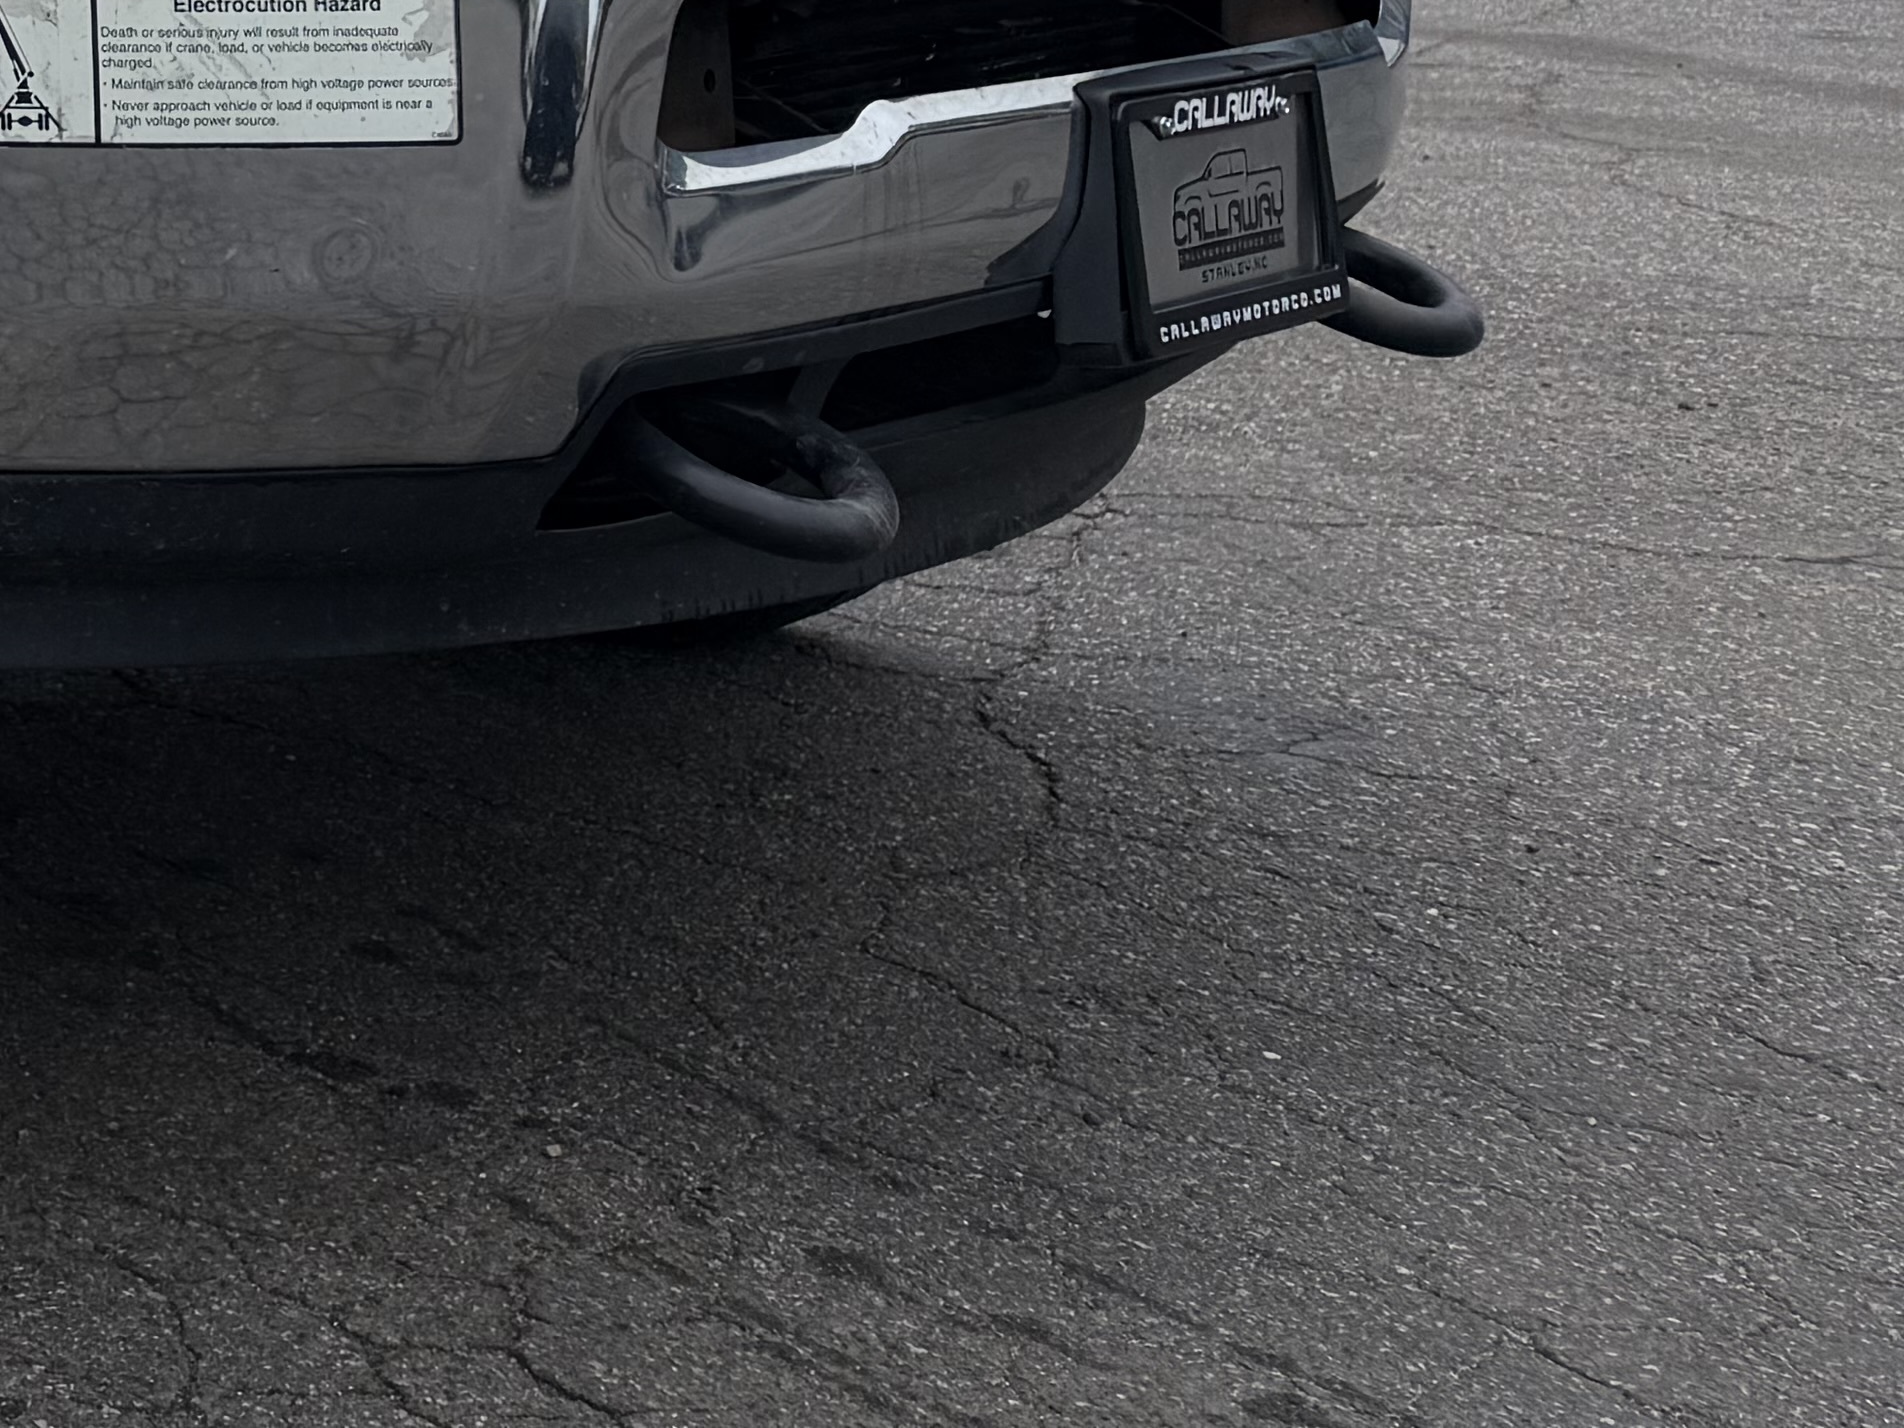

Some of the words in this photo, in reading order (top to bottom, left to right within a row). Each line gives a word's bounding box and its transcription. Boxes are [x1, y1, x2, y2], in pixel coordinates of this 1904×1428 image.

[100, 26, 138, 39] Death
[141, 28, 155, 39] or
[157, 26, 204, 39] serious
[206, 26, 240, 42] injury
[243, 26, 263, 38] will
[265, 26, 299, 37] result
[302, 26, 330, 38] from
[333, 26, 399, 41] inadequate
[100, 42, 162, 54] clearance
[251, 43, 265, 54] or
[268, 41, 310, 53] vehicle
[313, 40, 368, 53] becomes
[371, 40, 433, 54] electrically
[111, 77, 164, 92] Maintain
[167, 78, 194, 90] safe
[197, 78, 258, 90] clearance
[260, 78, 288, 90] from
[291, 77, 317, 92] high
[320, 77, 365, 92] voltage
[367, 79, 404, 91] power
[111, 99, 149, 112] Never
[152, 99, 211, 114] approach
[213, 99, 257, 112] vehicle
[260, 101, 273, 111] or
[276, 99, 303, 111] load
[305, 99, 313, 111] if
[316, 99, 380, 113] equipment
[382, 98, 393, 110] is
[395, 100, 423, 110] near
[426, 101, 433, 110] a
[1173, 85, 1275, 133] CALLAWAY
[115, 115, 142, 129] high
[145, 115, 190, 129] voltage
[193, 117, 232, 129] power
[1172, 190, 1285, 247] CALLAWAY
[1159, 284, 1342, 344] CALLAWAYMOTORCO.COM
